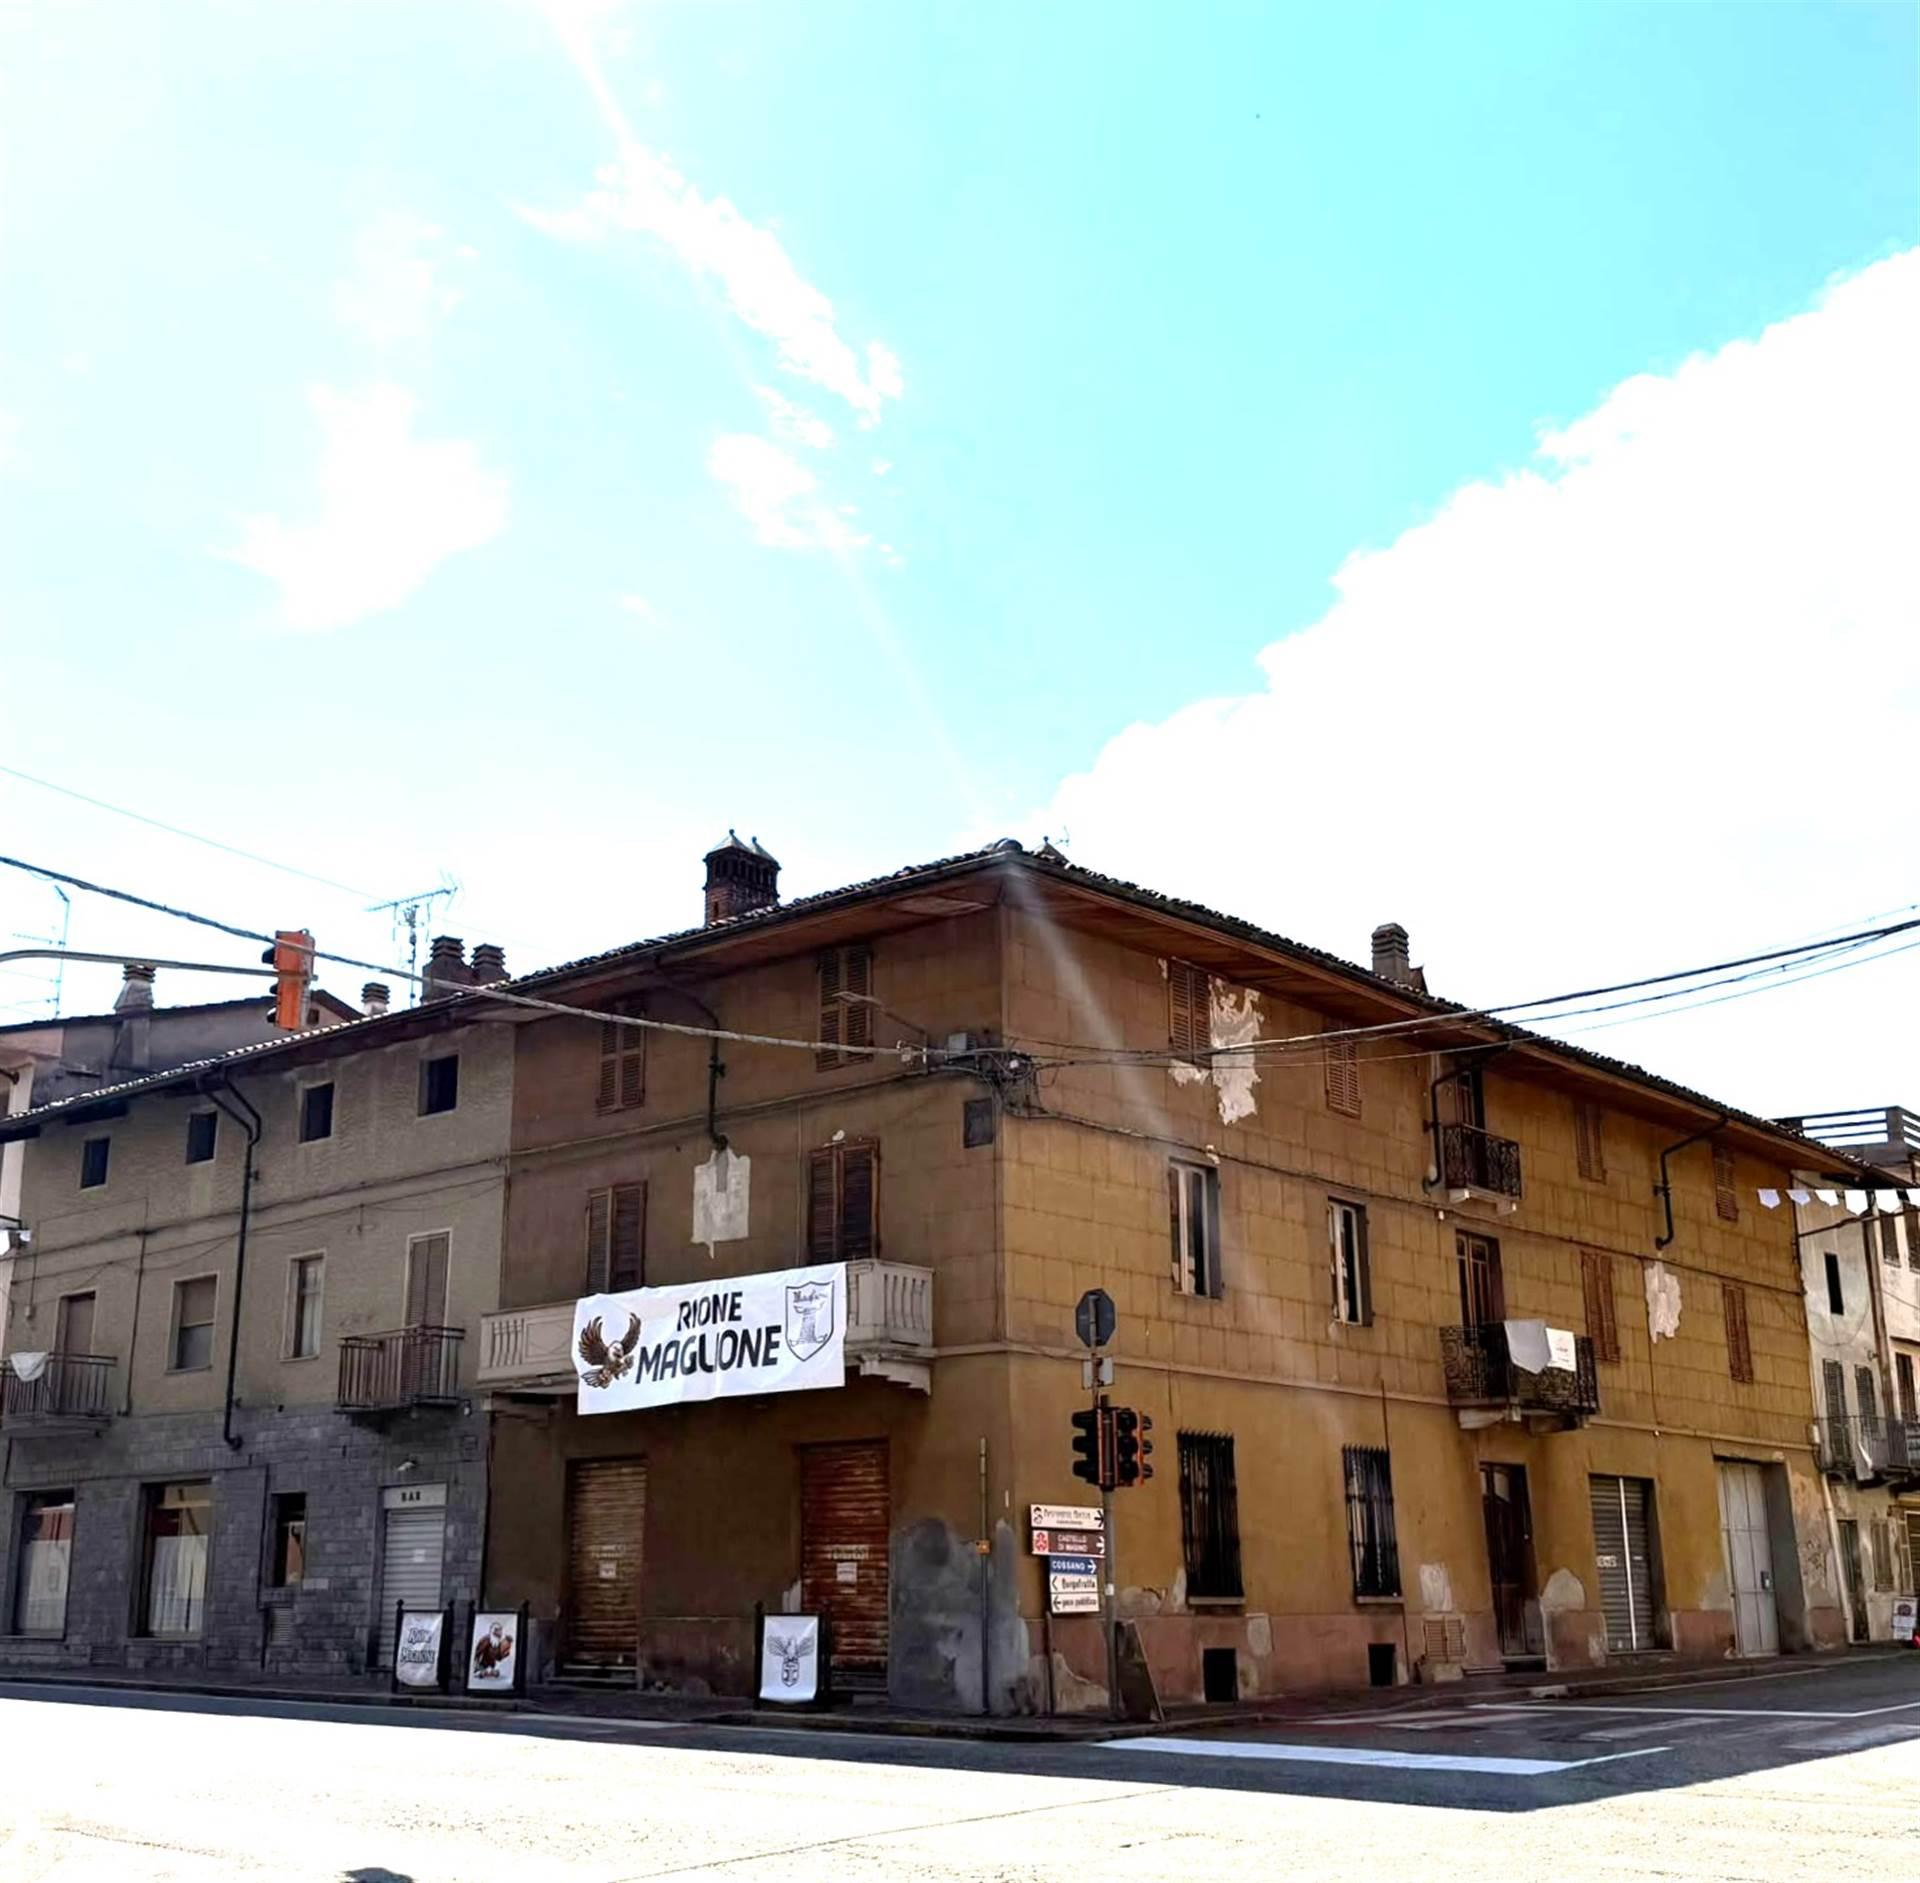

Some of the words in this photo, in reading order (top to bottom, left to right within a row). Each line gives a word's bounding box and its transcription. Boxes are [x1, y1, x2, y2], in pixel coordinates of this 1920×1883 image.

[677, 1291, 743, 1332] RIONE
[635, 1324, 782, 1384] MAGLIONE
[1052, 1560, 1086, 1571] COSSANO
